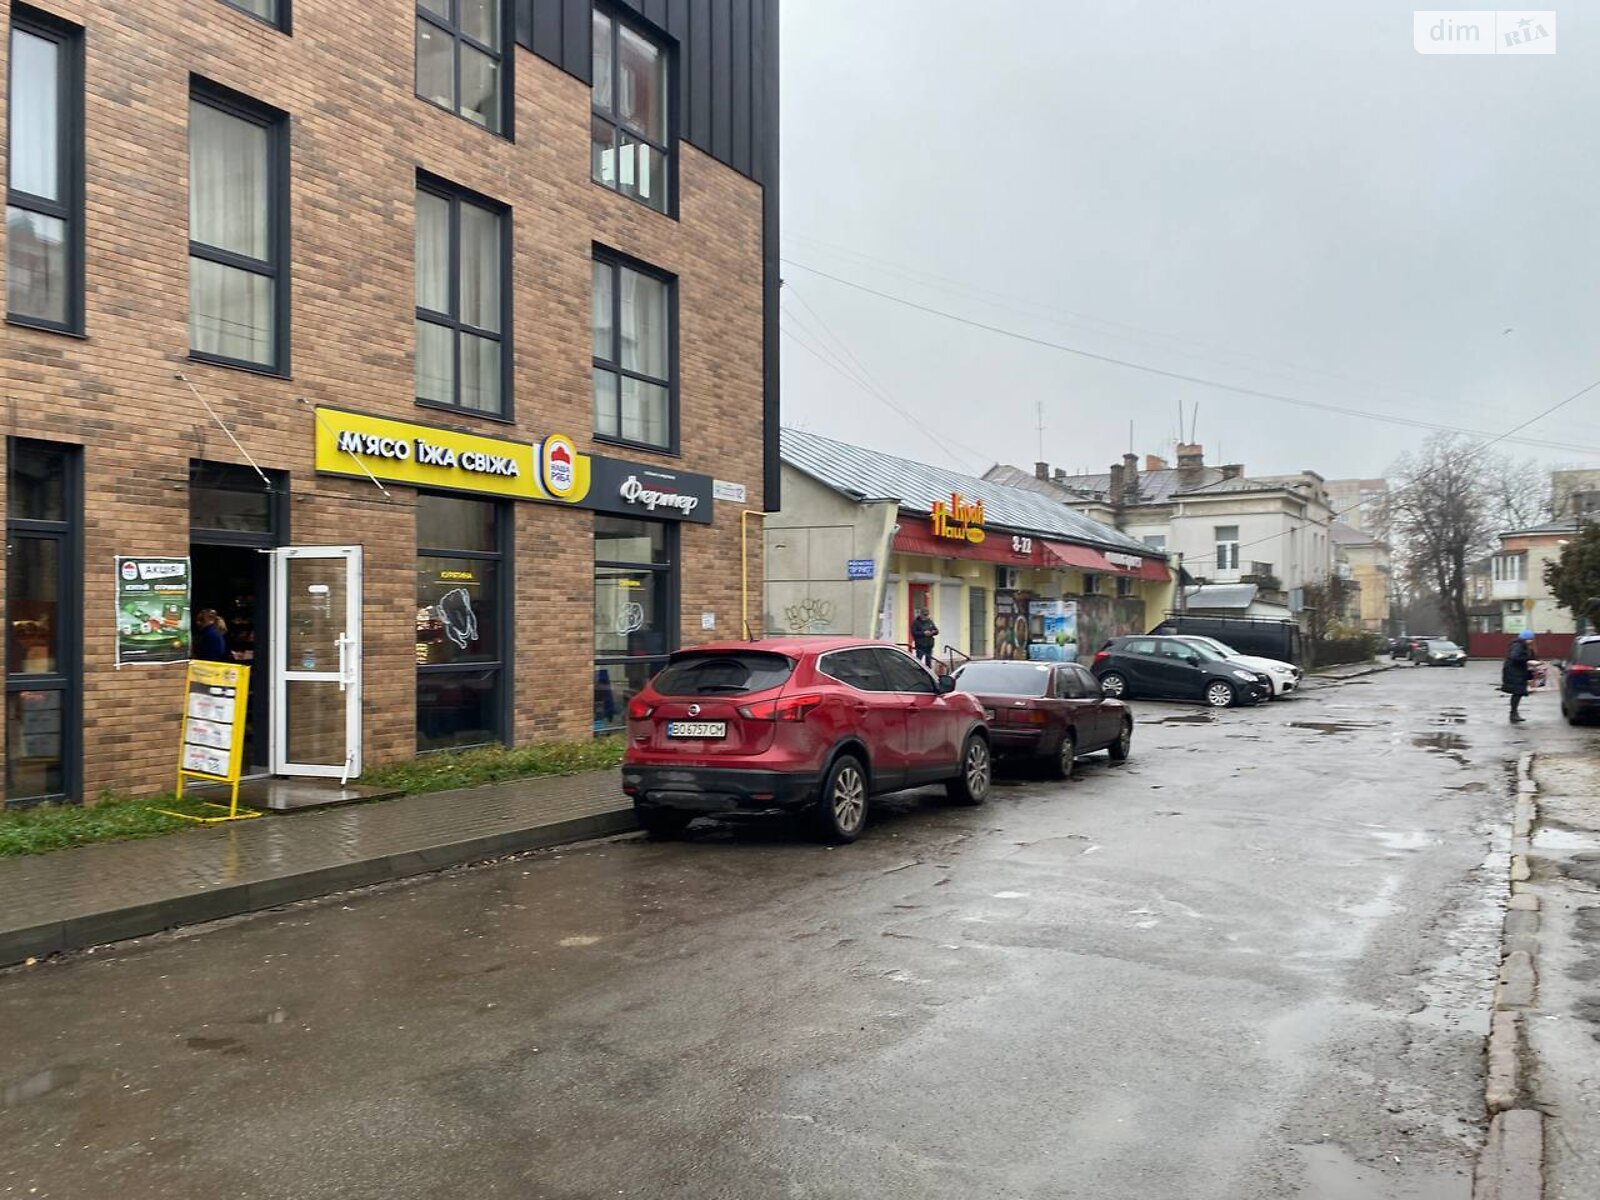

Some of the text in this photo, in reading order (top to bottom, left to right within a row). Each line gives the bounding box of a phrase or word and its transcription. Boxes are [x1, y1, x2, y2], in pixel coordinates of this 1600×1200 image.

[338, 430, 521, 478] М'ЯСО ЇЖА СВІЖА
